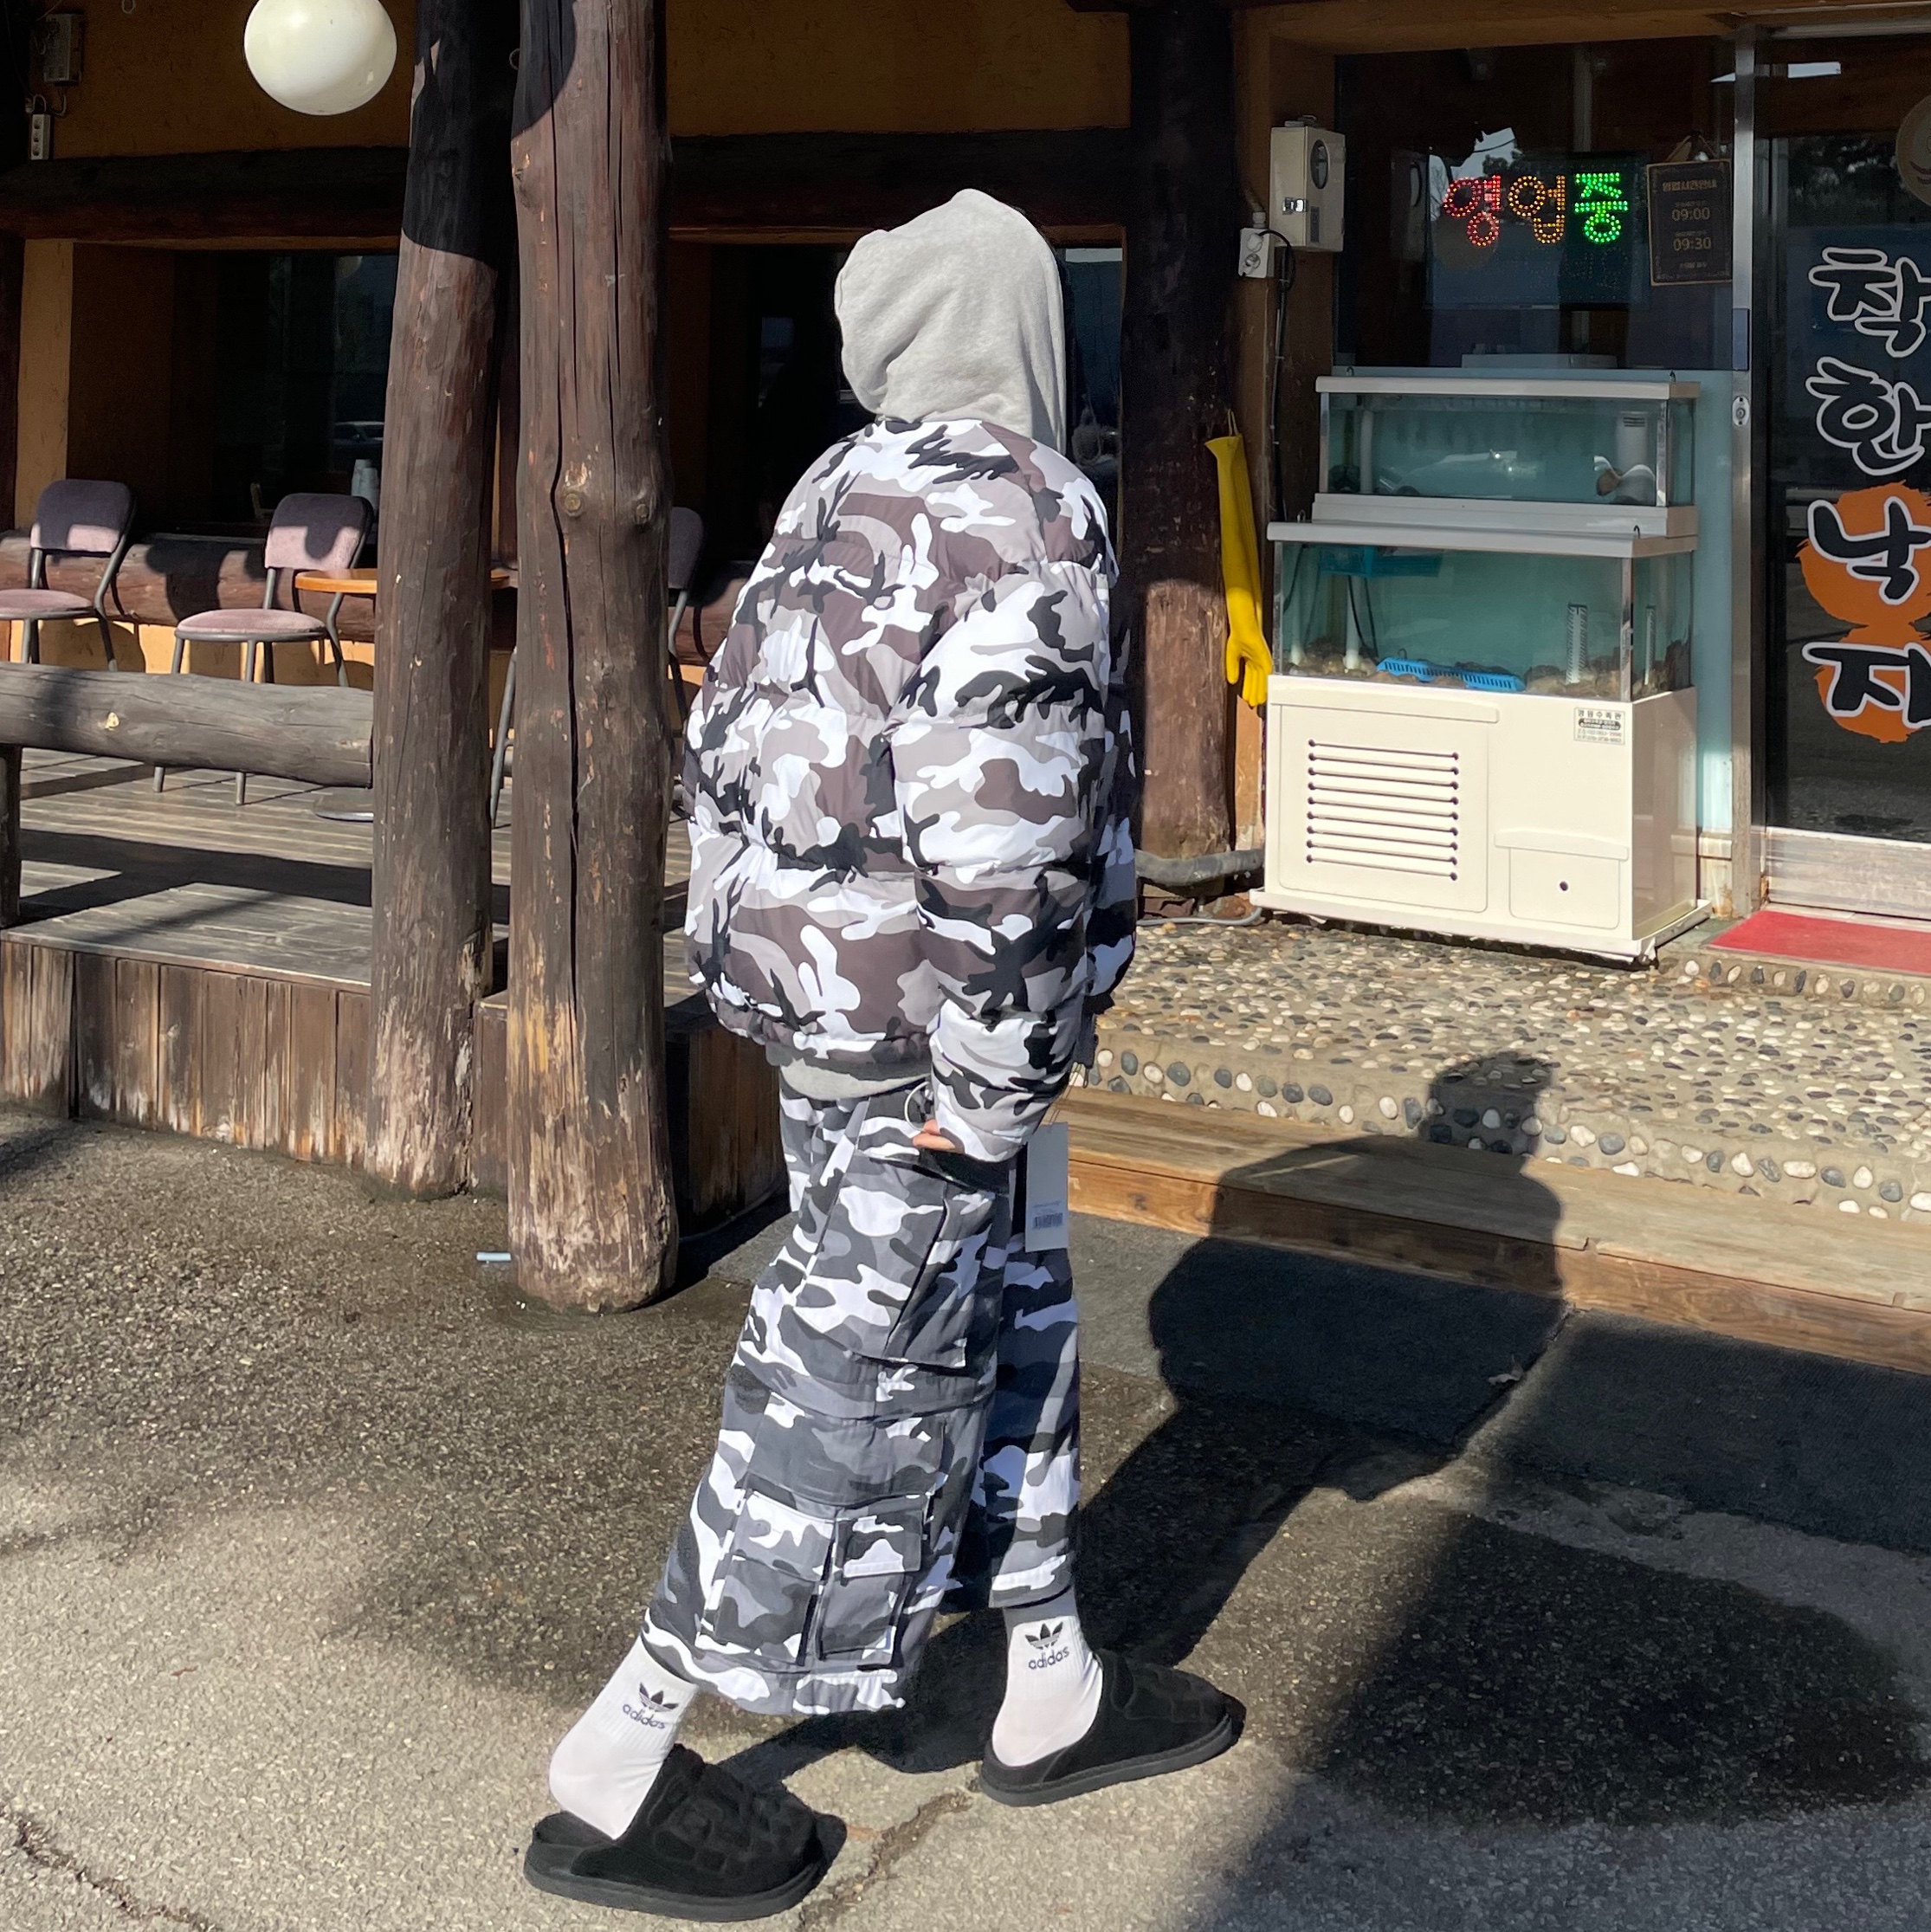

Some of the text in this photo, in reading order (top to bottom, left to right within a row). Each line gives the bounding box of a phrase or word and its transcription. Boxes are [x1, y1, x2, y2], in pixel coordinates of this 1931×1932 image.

[1443, 172, 1629, 248] 영업중
[1671, 207, 1710, 222] 09:00
[1673, 236, 1712, 252] 09:30
[1028, 1646, 1070, 1670] adidas
[623, 1703, 666, 1729] adidas
